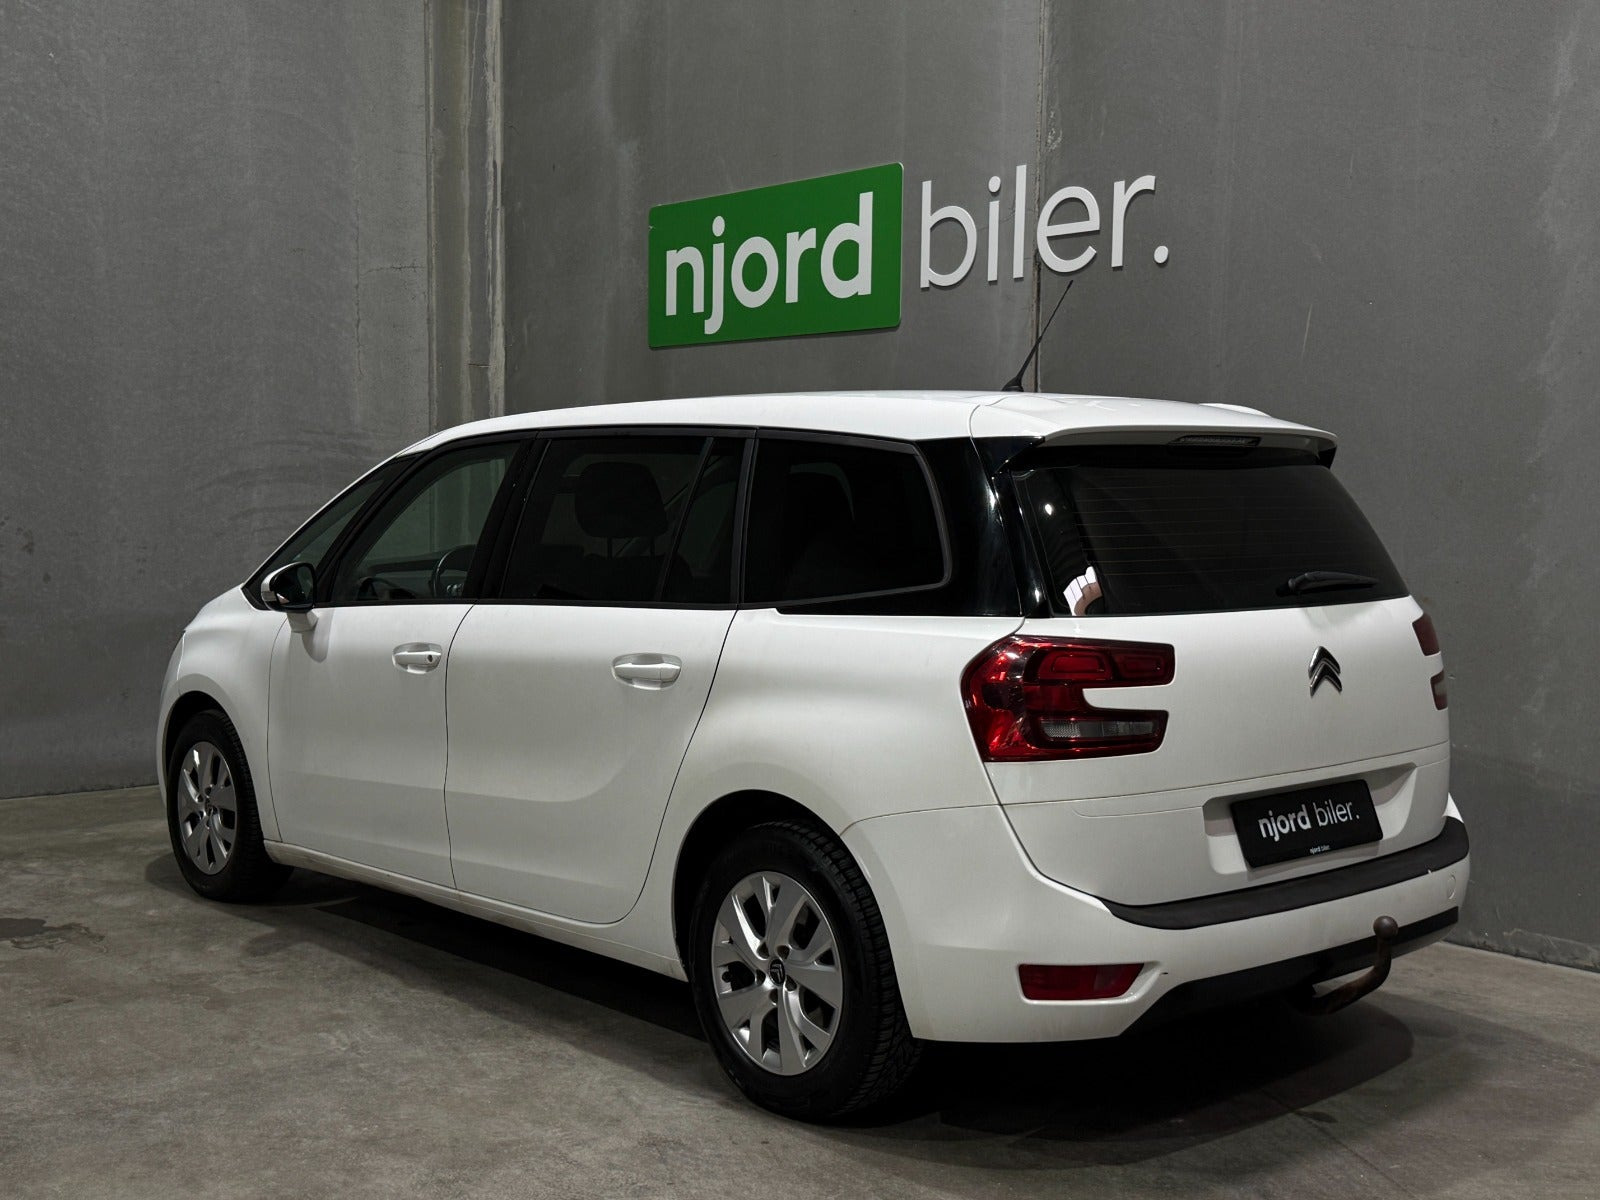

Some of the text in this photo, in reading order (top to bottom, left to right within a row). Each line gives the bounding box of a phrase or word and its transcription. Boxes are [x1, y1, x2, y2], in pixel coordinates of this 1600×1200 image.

[665, 164, 1169, 335] njord biler.
[1258, 799, 1360, 842] njord biler.
